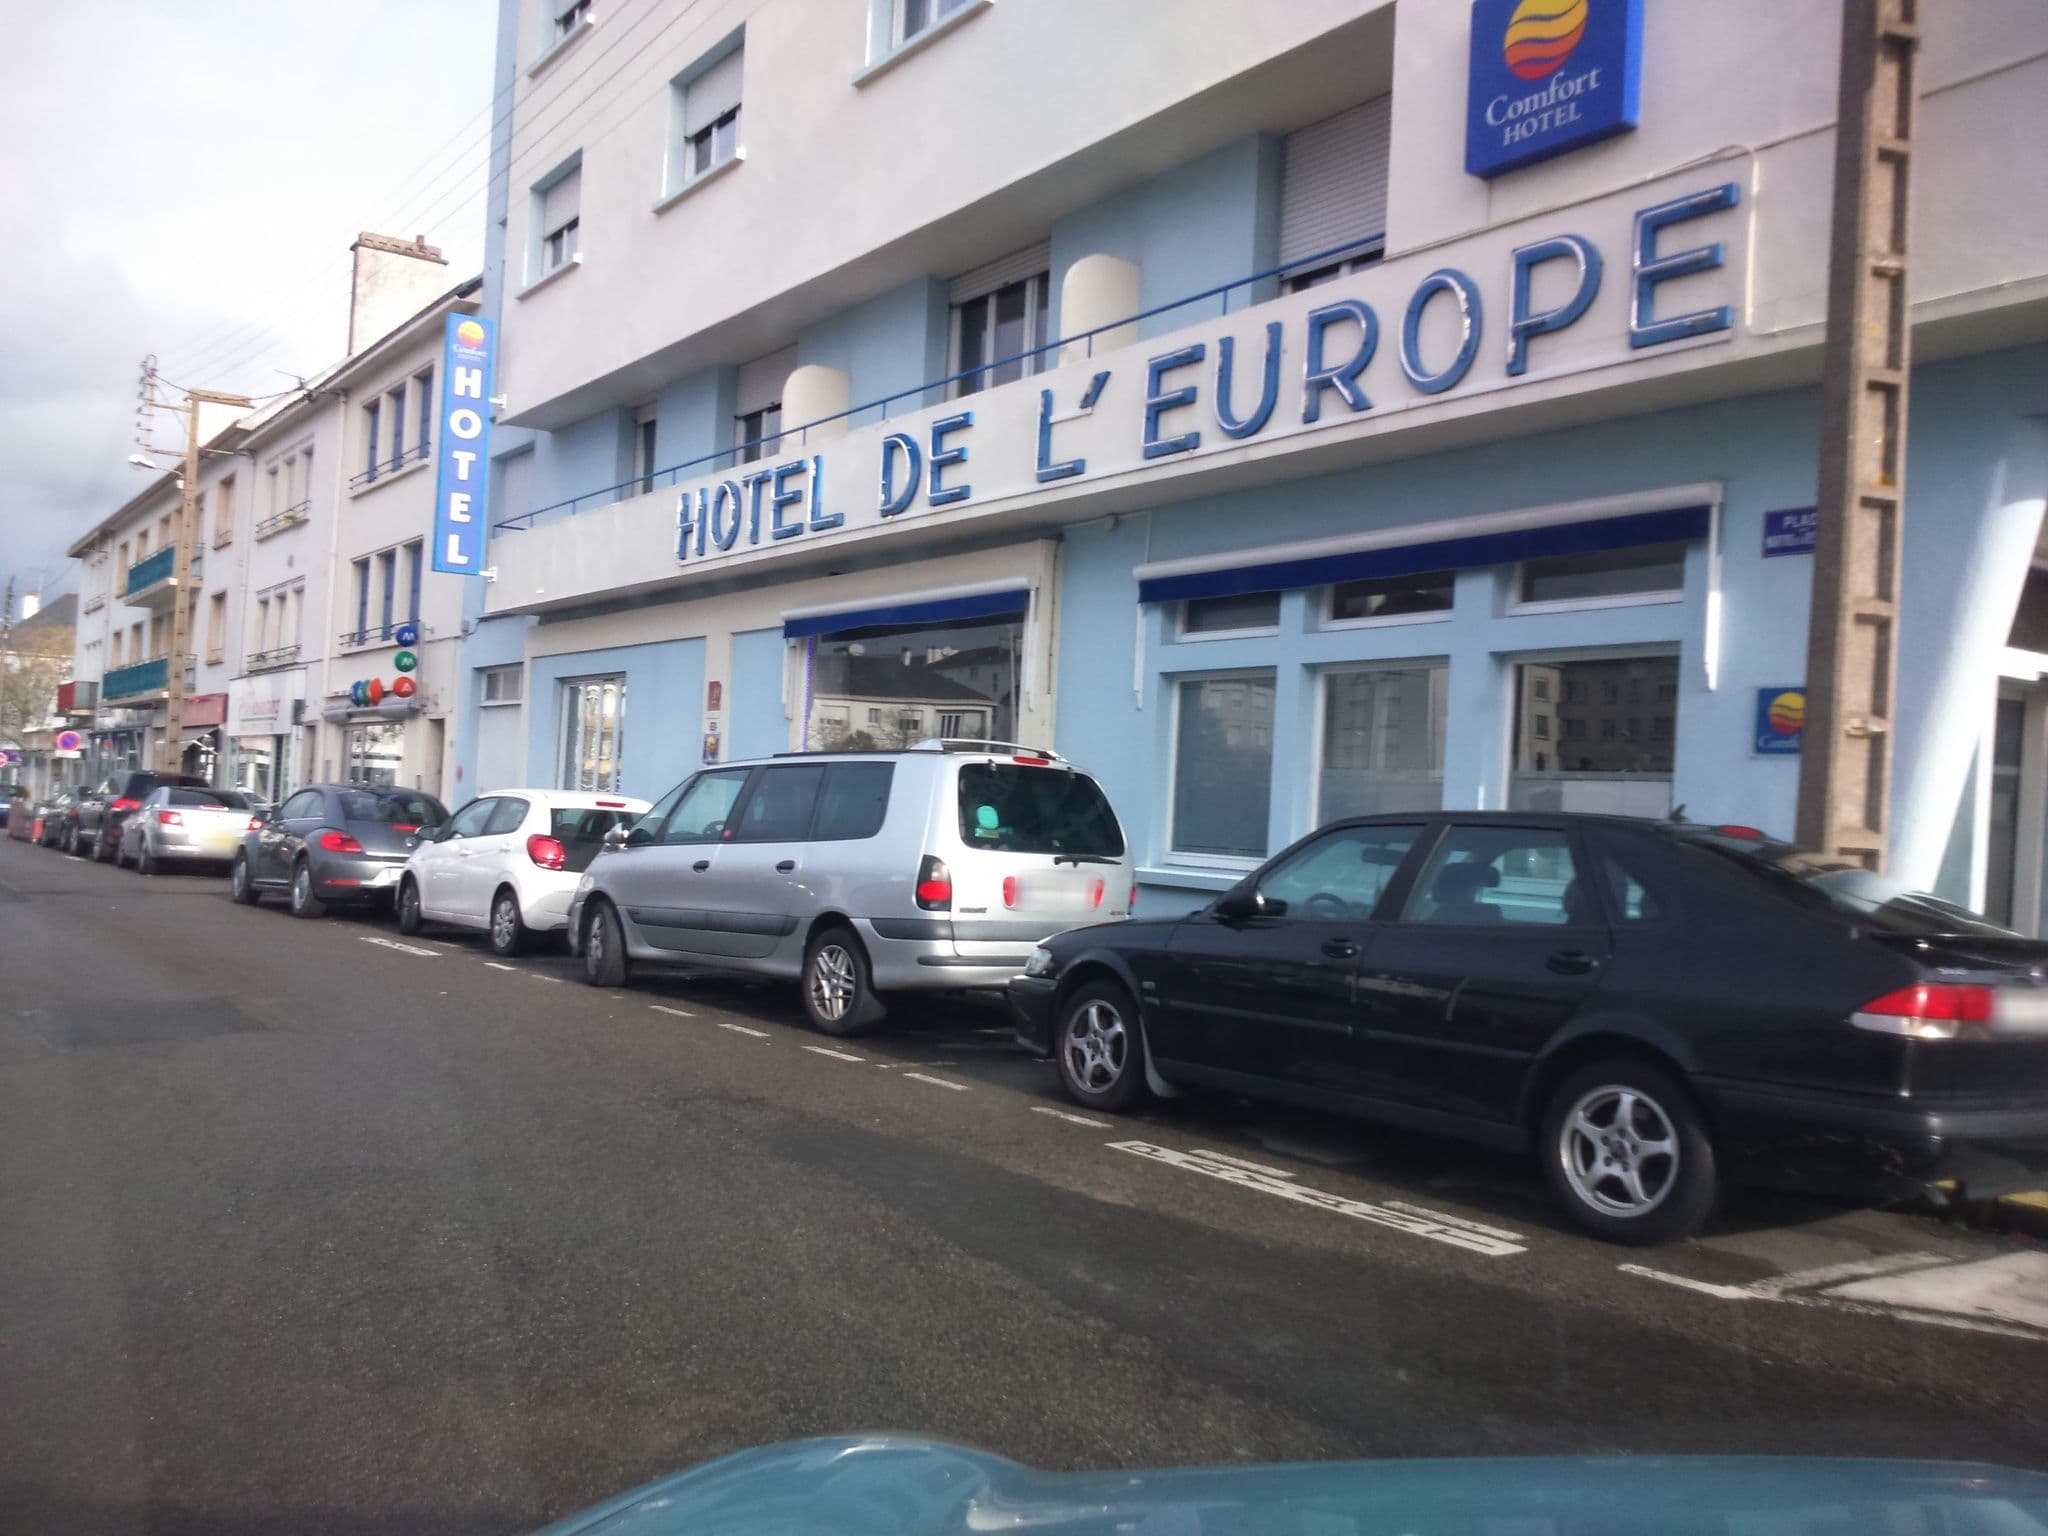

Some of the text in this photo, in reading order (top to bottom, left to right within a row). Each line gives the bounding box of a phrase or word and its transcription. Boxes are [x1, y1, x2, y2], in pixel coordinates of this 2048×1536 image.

[1486, 67, 1601, 127] Comfort
[1503, 102, 1582, 146] HOTEL
[675, 182, 1739, 560] HOTEL DE L'EUROPE
[447, 366, 482, 565] HOTEL
[1120, 1143, 1497, 1249] PAYANT
